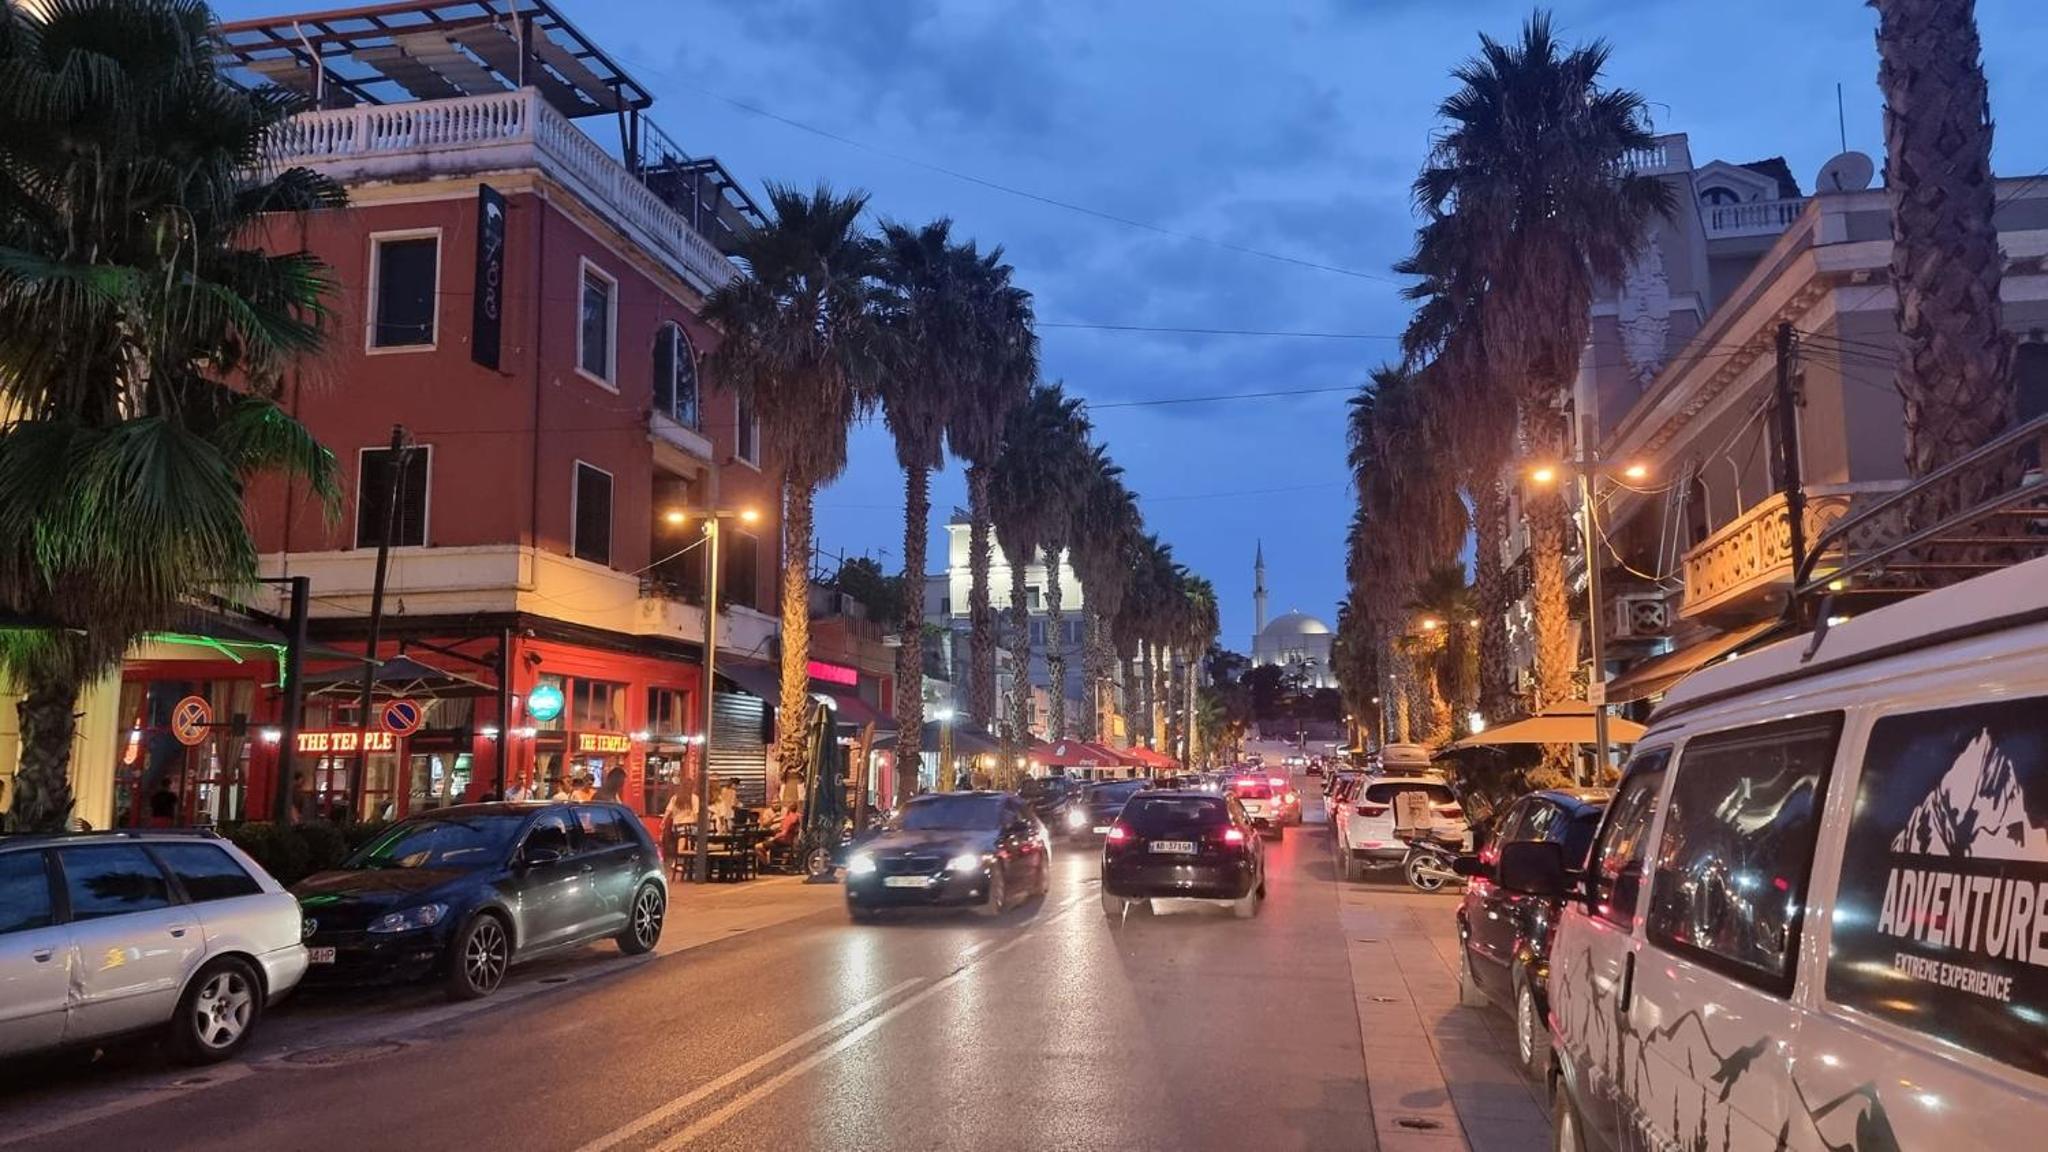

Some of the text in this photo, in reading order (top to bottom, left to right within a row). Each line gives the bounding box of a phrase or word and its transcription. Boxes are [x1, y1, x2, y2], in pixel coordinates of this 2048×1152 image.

[297, 733, 329, 752] THE
[580, 733, 631, 752] THE TEMPLE
[1877, 868, 2048, 967] ADVENTURE
[1895, 953, 2012, 1001] EXTREME EXPERIENCE
